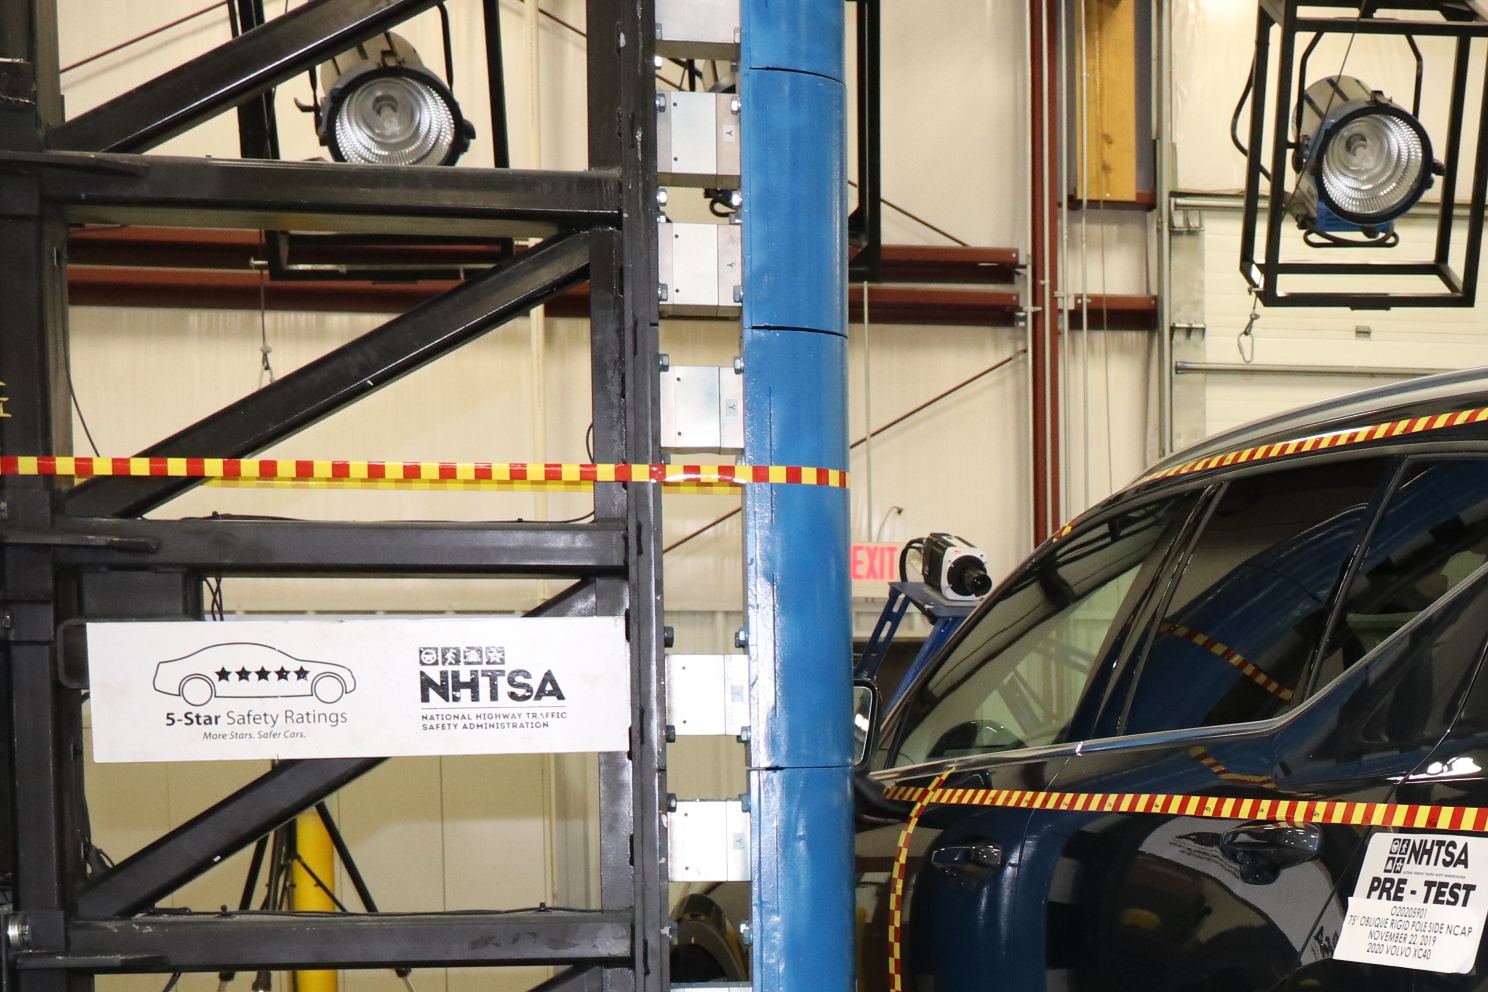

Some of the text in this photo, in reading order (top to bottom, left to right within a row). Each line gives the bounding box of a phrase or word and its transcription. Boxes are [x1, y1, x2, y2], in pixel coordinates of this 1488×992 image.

[851, 545, 898, 580] EXIT
[420, 668, 566, 703] NHTSA
[166, 709, 348, 728] 5-Star Safety Ratings
[421, 711, 567, 721] NATIONAL HIGHWAY TRAFFIC
[203, 730, 306, 740] More Stars. Safer Cars.
[422, 721, 549, 731] SAFETY ADMINISTRATION
[1407, 839, 1468, 869] NHTSA
[1366, 877, 1408, 901] PRE
[1423, 880, 1476, 907] TEST
[1360, 916, 1389, 929] OBLIQUE
[1390, 919, 1410, 931] RIGID
[1411, 921, 1427, 933] POLE
[1428, 922, 1443, 934] SIDE
[1446, 925, 1473, 937] NCAP
[1368, 930, 1407, 944] NOVEMBER
[1419, 935, 1437, 946] 2019
[1366, 943, 1432, 960] 2020 VOLVO XC40
